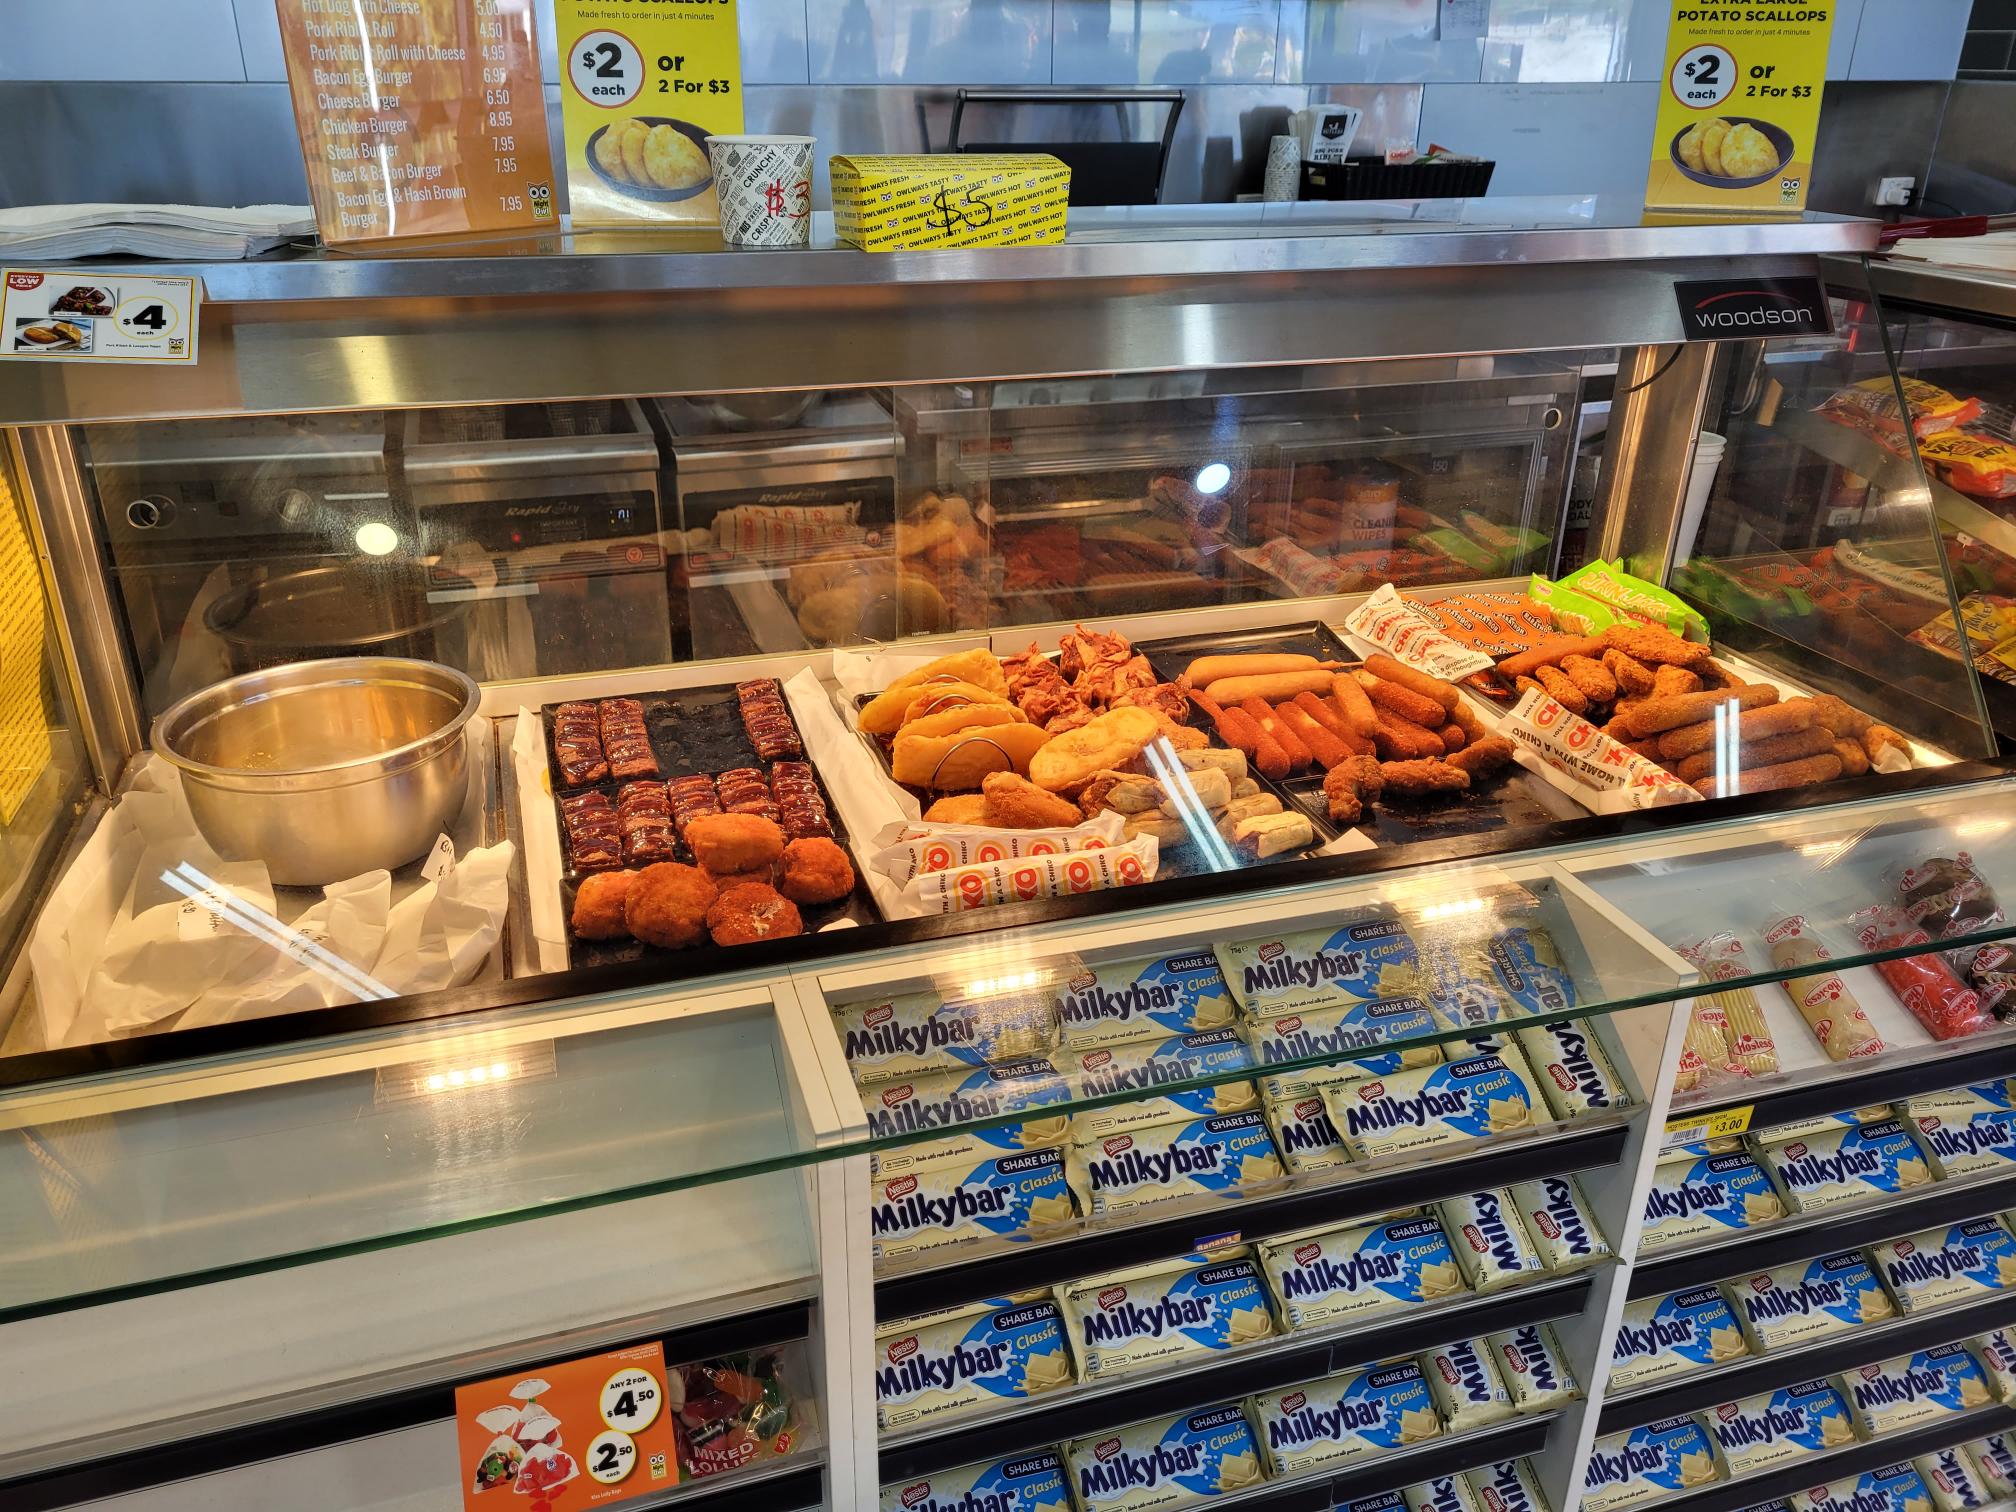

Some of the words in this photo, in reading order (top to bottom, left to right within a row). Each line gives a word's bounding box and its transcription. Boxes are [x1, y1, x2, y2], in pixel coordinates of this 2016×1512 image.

[577, 10, 599, 18] Made
[662, 12, 677, 20] just
[1677, 11, 1741, 21] POTATO
[1745, 11, 1827, 21] SCALLOPS
[305, 21, 333, 37] Pork
[372, 21, 395, 37] Roll
[480, 23, 502, 38] 4.50
[310, 44, 337, 61] Pork
[376, 44, 399, 61] Roll
[401, 44, 425, 60] with
[427, 44, 466, 61] Cheese
[482, 45, 505, 60] 4.95
[583, 42, 624, 78] $2
[657, 55, 684, 71] or
[314, 69, 352, 86] Bacon
[375, 69, 412, 86] Burger
[1684, 54, 1720, 84] $2
[1750, 65, 1775, 79] or
[592, 84, 626, 96] each
[658, 80, 669, 93] 2
[674, 80, 703, 93] For
[708, 79, 730, 95] $3
[1687, 89, 1716, 99] each
[1746, 86, 1756, 97] 2
[1760, 86, 1787, 97] For
[1792, 85, 1812, 98] $3
[318, 93, 360, 110] Cheese
[486, 90, 510, 105] 6.50
[322, 118, 368, 135] Chicken
[369, 117, 408, 134] Burger
[489, 111, 512, 127] 8.95
[327, 143, 359, 160] Steak
[492, 136, 515, 152] 7.95
[332, 167, 358, 183] Beef
[360, 166, 369, 181] &
[406, 163, 442, 180] Burger
[494, 157, 517, 173] 7.95
[743, 150, 777, 188] CRUNCHY
[337, 190, 372, 208] Bacon
[404, 188, 432, 202] Hash
[433, 185, 466, 201] Brown
[500, 196, 523, 212] 7.95
[896, 181, 929, 197] OWLWAYS
[929, 177, 950, 188] TASTY
[975, 188, 1007, 201] OWLWAYS
[1007, 183, 1021, 193] HOT
[1012, 191, 1044, 204] OWLWAYS
[1044, 186, 1058, 196] HOT
[895, 199, 916, 211] FRESH
[926, 184, 992, 237] $5
[341, 212, 378, 228] Burger
[751, 214, 774, 241] CRISPY
[1017, 216, 1050, 230] OWLWAYS
[1050, 211, 1063, 222] HOT
[867, 231, 901, 246] OWLWAYS
[901, 226, 922, 237] FRESH
[979, 230, 999, 241] TASTY
[122, 305, 167, 329] $4
[1695, 306, 1813, 327] woodson
[1352, 528, 1386, 541] WIPES
[1410, 601, 1441, 622] MARATHON
[1438, 606, 1472, 630] MARATHON
[1466, 608, 1499, 633] MARATHON
[960, 840, 968, 865] CHIKO
[1355, 925, 1384, 939] SHARE
[1387, 923, 1403, 935] BAR
[1370, 939, 1405, 960] Classic
[1171, 958, 1203, 971] SHARE
[1244, 950, 1364, 993] Milkybar
[1057, 981, 1180, 1022] Milkybar
[1372, 1002, 1402, 1015] SHARE
[1404, 1000, 1422, 1012] BAR
[1390, 1012, 1427, 1035] Classic
[845, 1014, 980, 1060] Milkybar
[1205, 1044, 1243, 1066] Classic
[1455, 1061, 1485, 1076] SHARE
[1474, 1073, 1511, 1096] Classic
[1346, 1088, 1468, 1136] Milkybar
[1714, 1118, 1743, 1132] $3.00
[1002, 1157, 1037, 1172] SHARE
[1040, 1150, 1061, 1165] BAR
[1089, 1140, 1222, 1191] Milkybar
[1778, 1146, 1880, 1190] Milkybar
[1019, 1169, 1065, 1194] Classic
[872, 1181, 1012, 1236] Milkybar
[1391, 1225, 1420, 1239] SHARE
[1423, 1221, 1440, 1232] BAR
[1408, 1235, 1446, 1260] Classic
[1282, 1251, 1402, 1300] Milkybar
[1887, 1243, 1980, 1288] Milkybar
[999, 1312, 1033, 1328] SHARE
[1035, 1305, 1055, 1321] BAR
[1083, 1295, 1212, 1346] Milkybar
[1016, 1322, 1058, 1350] Classic
[876, 1341, 1009, 1400] Milkybar
[610, 1381, 625, 1390] ANY
[626, 1378, 632, 1386] 2
[633, 1376, 647, 1385] FOR
[1855, 1363, 1944, 1410] Milkybar
[607, 1389, 655, 1418] $4.50
[1389, 1384, 1425, 1407] Classic
[1193, 1414, 1225, 1429] SHARE
[1227, 1408, 1244, 1423] BAR
[1268, 1398, 1384, 1449] Milkybar
[1209, 1427, 1248, 1451] Classic
[592, 1442, 633, 1473] $2.50
[693, 1442, 754, 1462] MIXED
[1080, 1440, 1203, 1498] Milkybar
